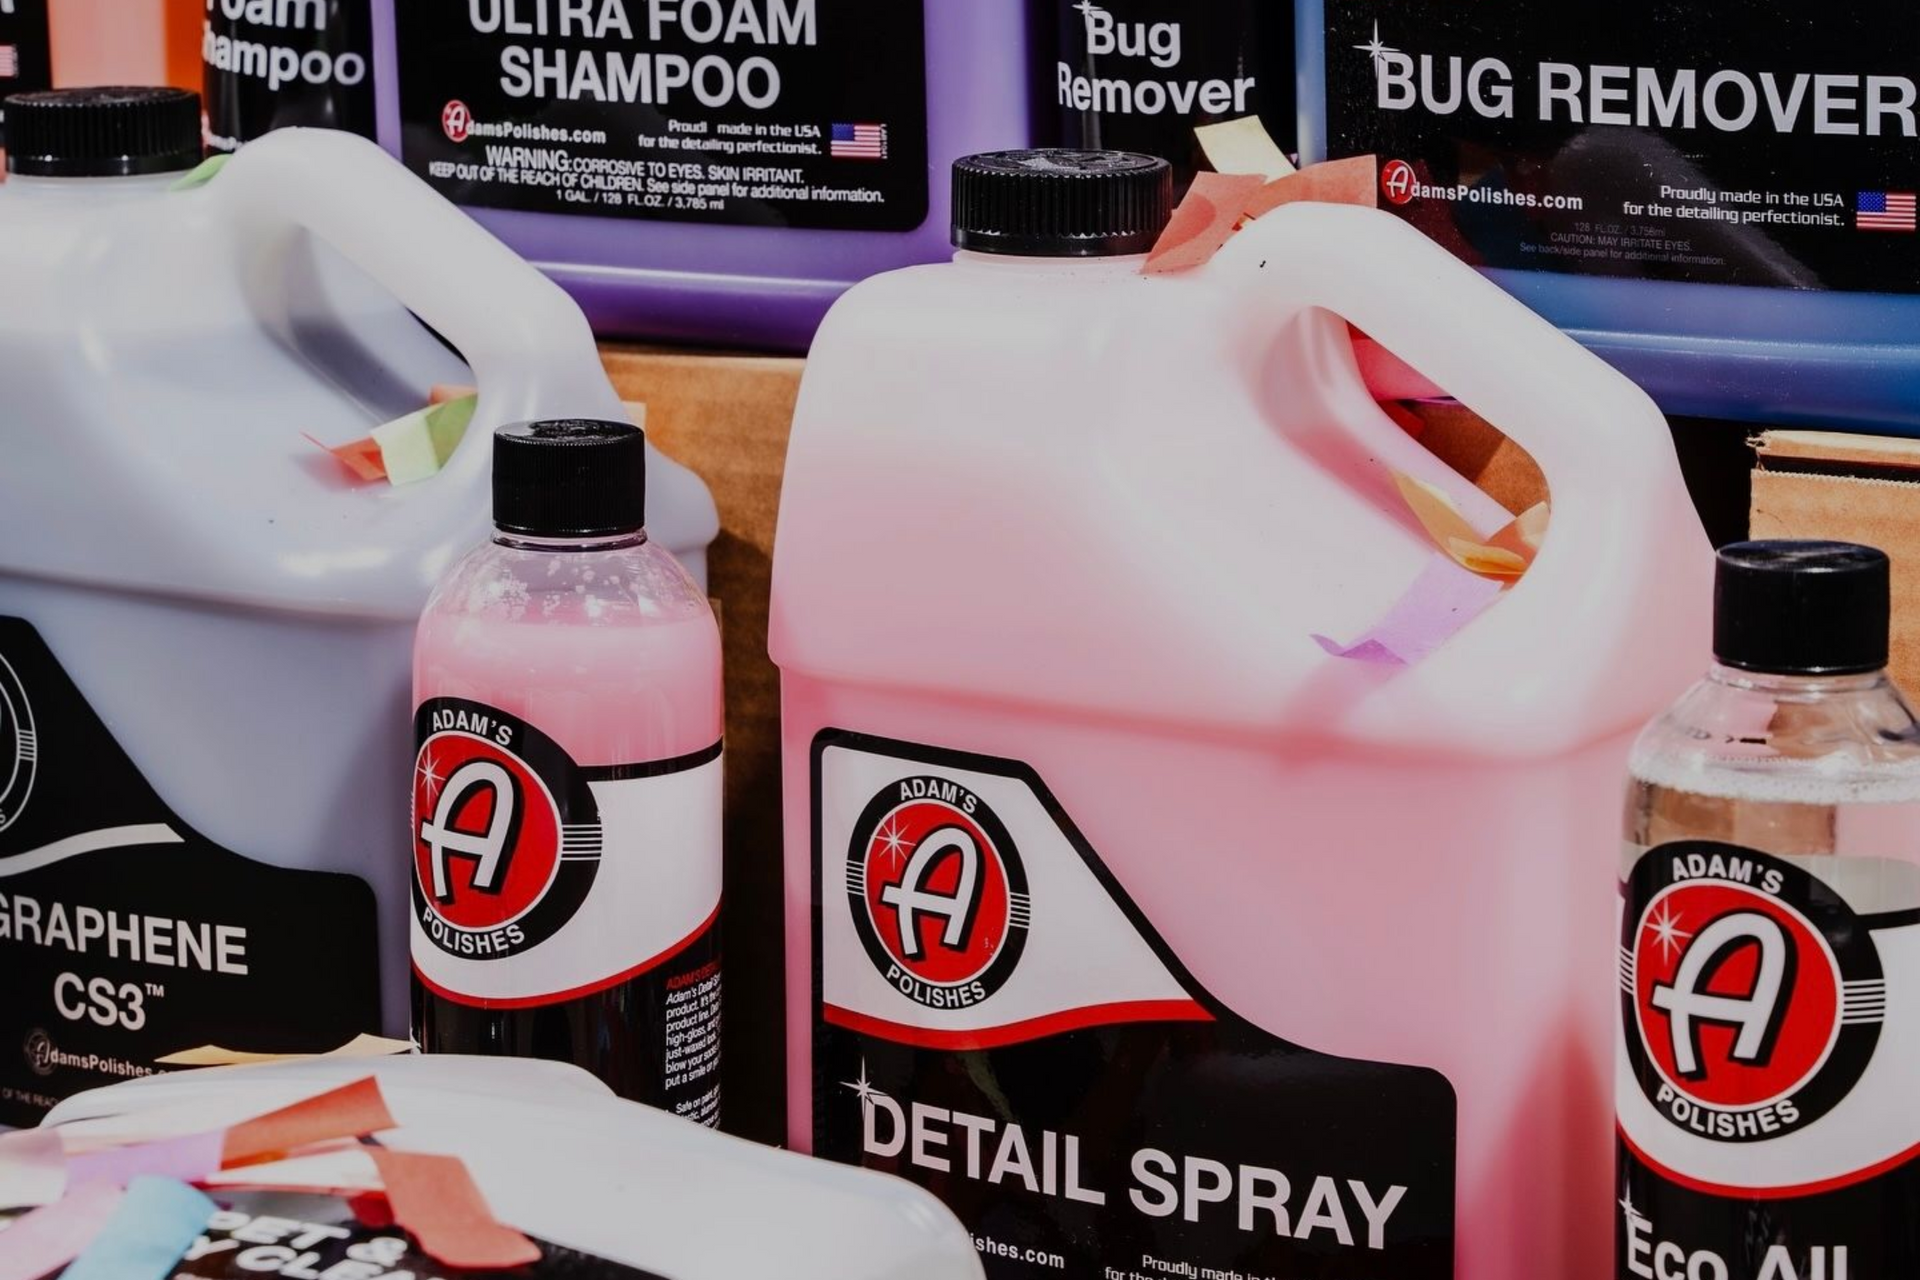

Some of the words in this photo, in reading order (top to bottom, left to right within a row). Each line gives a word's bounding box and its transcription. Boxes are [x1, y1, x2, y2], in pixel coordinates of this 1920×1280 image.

[206, 0, 326, 30] oam
[648, 0, 817, 45] FOAM
[202, 20, 365, 91] hampoo
[1087, 10, 1181, 68] Bug
[500, 46, 780, 108] SHAMPOO
[1057, 62, 1255, 115] Remover
[1376, 51, 1513, 119] BUG
[1539, 62, 1918, 137] REMOVER
[638, 135, 655, 148] for
[658, 137, 679, 150] the
[681, 137, 734, 154] detailing
[737, 141, 822, 155] perfectionist.
[668, 120, 707, 133] Proudl
[718, 124, 752, 135] made
[755, 124, 767, 135] in
[770, 124, 791, 137] the
[795, 126, 821, 138] USA
[429, 161, 455, 178] KEEP
[456, 164, 478, 180] OUT
[480, 166, 495, 181] OF
[498, 167, 519, 183] THE
[521, 169, 560, 186] REACH
[562, 172, 578, 187] OF
[580, 173, 644, 192] CHILDREN.
[647, 178, 669, 194] See
[672, 180, 696, 195] side
[698, 182, 729, 199] panel
[732, 183, 748, 198] for
[751, 184, 808, 200] additional
[811, 186, 884, 202] information.
[485, 145, 572, 172] WARNING:
[573, 157, 644, 176] CORROSIVE
[648, 162, 666, 177] TO
[668, 163, 704, 179] EYES.
[708, 165, 739, 181] SKIN
[743, 167, 804, 184] IRRITANT.
[557, 190, 562, 200] 1
[603, 192, 621, 204] 128
[710, 198, 724, 210] ml
[1386, 166, 1583, 210] AdamsPolishes.com
[1661, 186, 1716, 204] Proudly
[1720, 188, 1760, 204] made
[1766, 189, 1779, 204] in
[1784, 190, 1809, 206] the
[1814, 193, 1844, 208] USA
[1575, 222, 1590, 233] 128
[1623, 202, 1644, 216] for
[1648, 203, 1673, 219] the
[1676, 205, 1739, 225] detailing
[1743, 208, 1845, 228] perfectionist.
[1520, 242, 1537, 253] See
[1539, 244, 1581, 257] back/side
[1584, 246, 1608, 259] panel
[1610, 248, 1622, 259] for
[1625, 249, 1669, 262] additional
[1671, 251, 1726, 266] information.
[1551, 232, 1595, 245] CAUTION:
[1597, 235, 1618, 247] MAY
[1621, 236, 1661, 249] IRRITATE
[1664, 239, 1692, 252] EYES.
[432, 708, 513, 746] ADAM'S
[900, 778, 977, 814] ADAM'S
[1672, 854, 1784, 896] ADAM'S
[423, 907, 525, 955] POLISHES
[886, 964, 985, 1008] POLISHES
[666, 1014, 697, 1034] product
[665, 1074, 680, 1090] put
[682, 1074, 687, 1083] a
[666, 1059, 687, 1075] blow
[688, 1053, 703, 1070] your
[33, 1092, 59, 1108] REAC
[676, 1100, 692, 1114] Safe
[1656, 1083, 1800, 1138] POLISHES
[862, 1093, 1106, 1206] DETAIL
[1128, 1148, 1407, 1250] SPRAY
[207, 1212, 351, 1250] PET
[1627, 1213, 1728, 1280] Eco
[970, 1233, 1064, 1268] ishes.com
[1142, 1255, 1197, 1280] Proudly
